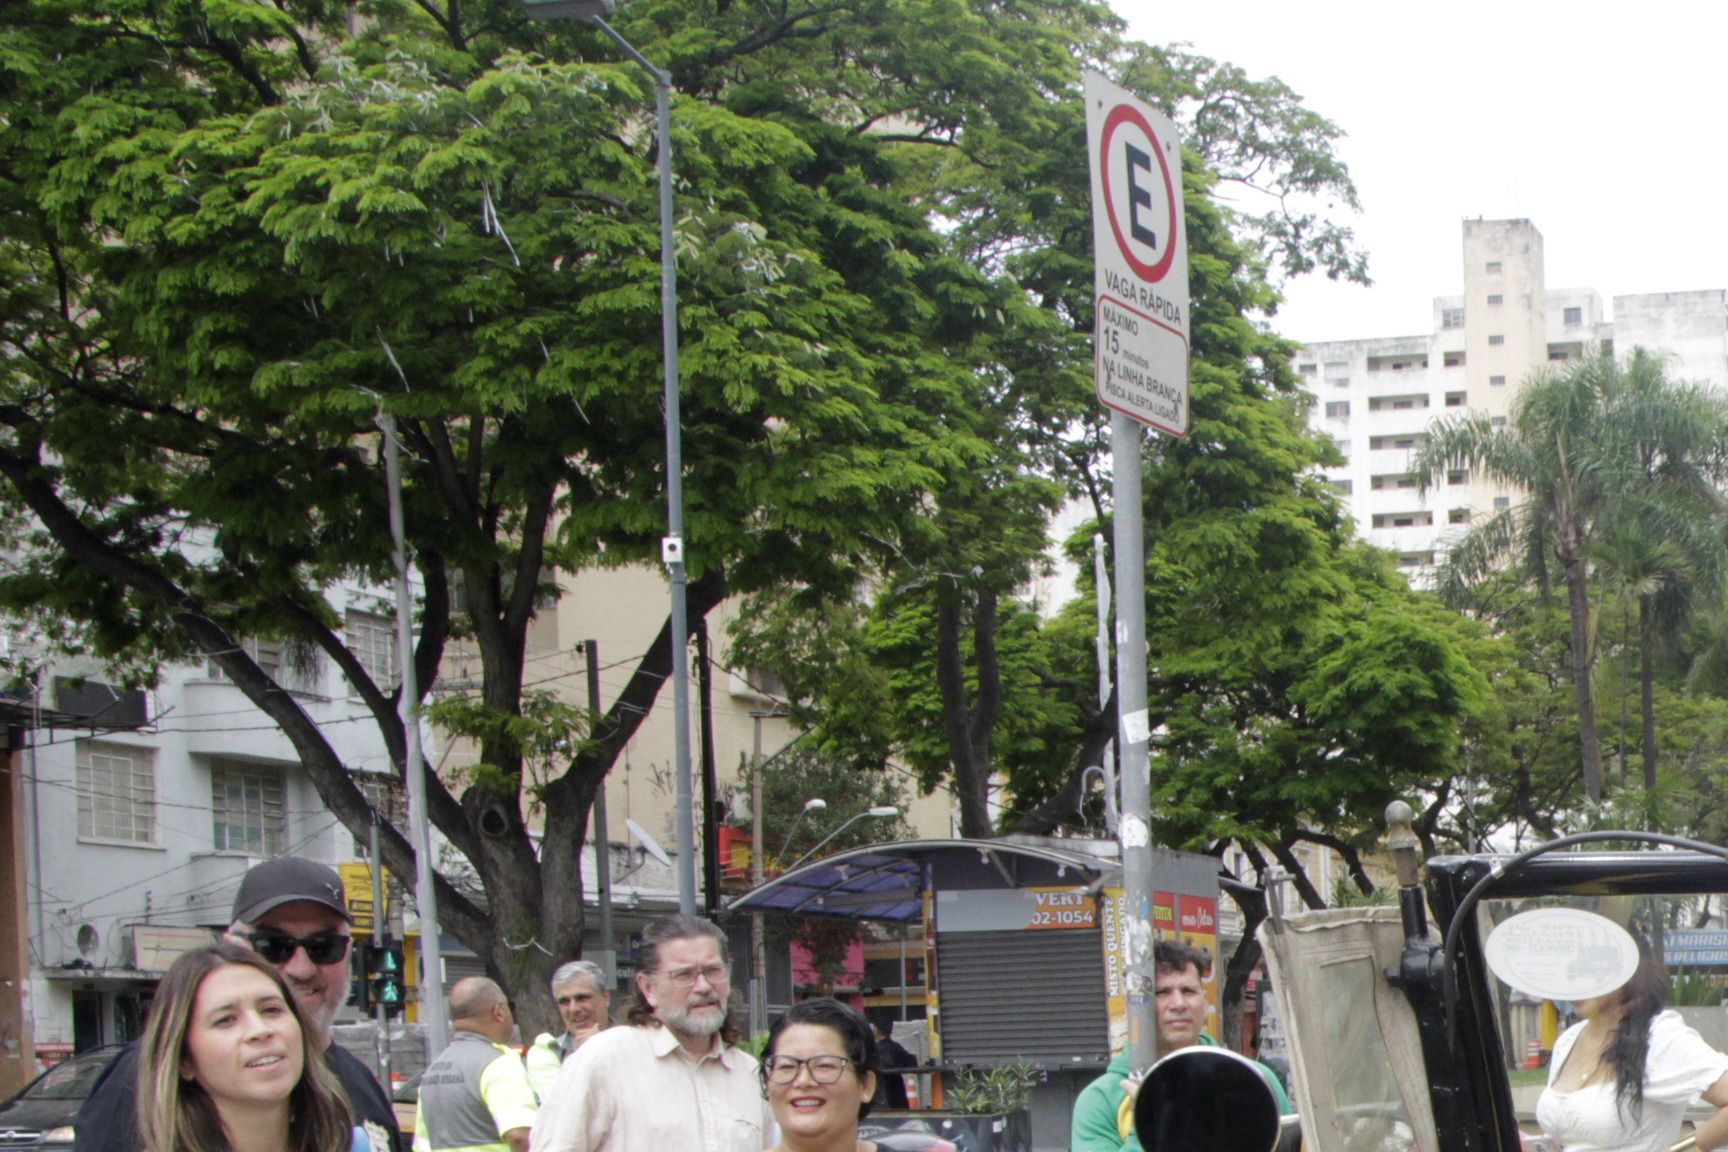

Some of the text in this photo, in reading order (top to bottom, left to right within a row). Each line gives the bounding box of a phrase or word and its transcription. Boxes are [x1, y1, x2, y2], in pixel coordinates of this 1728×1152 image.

[1126, 141, 1156, 250] E
[1103, 306, 1138, 336] MÁXIMO
[1105, 268, 1181, 326] VAGA RÁPIDA
[1104, 326, 1119, 354] 15
[1103, 356, 1183, 406] NA LINHA BRANCA
[1106, 380, 1126, 399] PISCA
[1127, 389, 1153, 412] ALERTA
[1105, 896, 1119, 996] MISTO QUENTE
